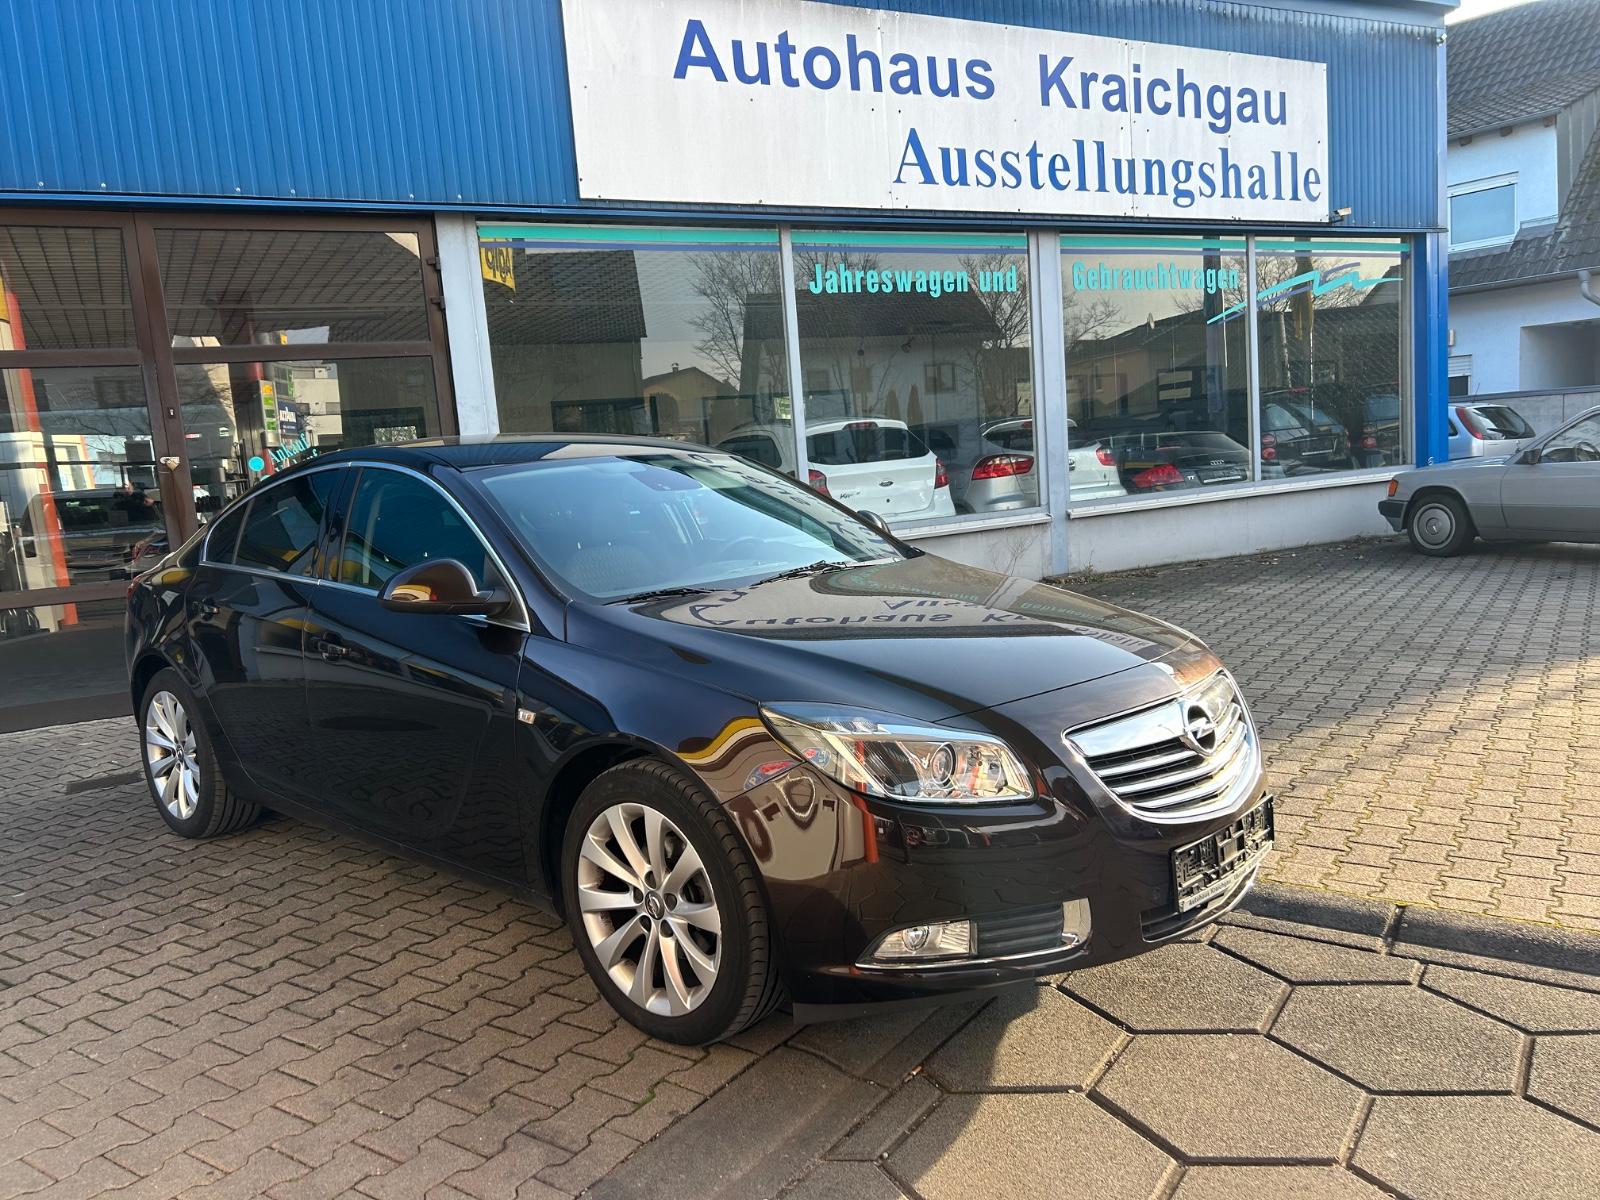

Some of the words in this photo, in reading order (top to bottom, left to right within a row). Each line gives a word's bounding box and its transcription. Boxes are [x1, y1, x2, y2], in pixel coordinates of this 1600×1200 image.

[673, 18, 995, 100] Autohaus
[1038, 53, 1288, 134] Kraichgau
[893, 127, 1322, 208] Ausstellungshalle
[808, 263, 969, 298] Jahreswagen
[979, 265, 1018, 293] und
[1072, 261, 1240, 295] Gebrauchtwagen
[267, 432, 311, 463] Ankauf
